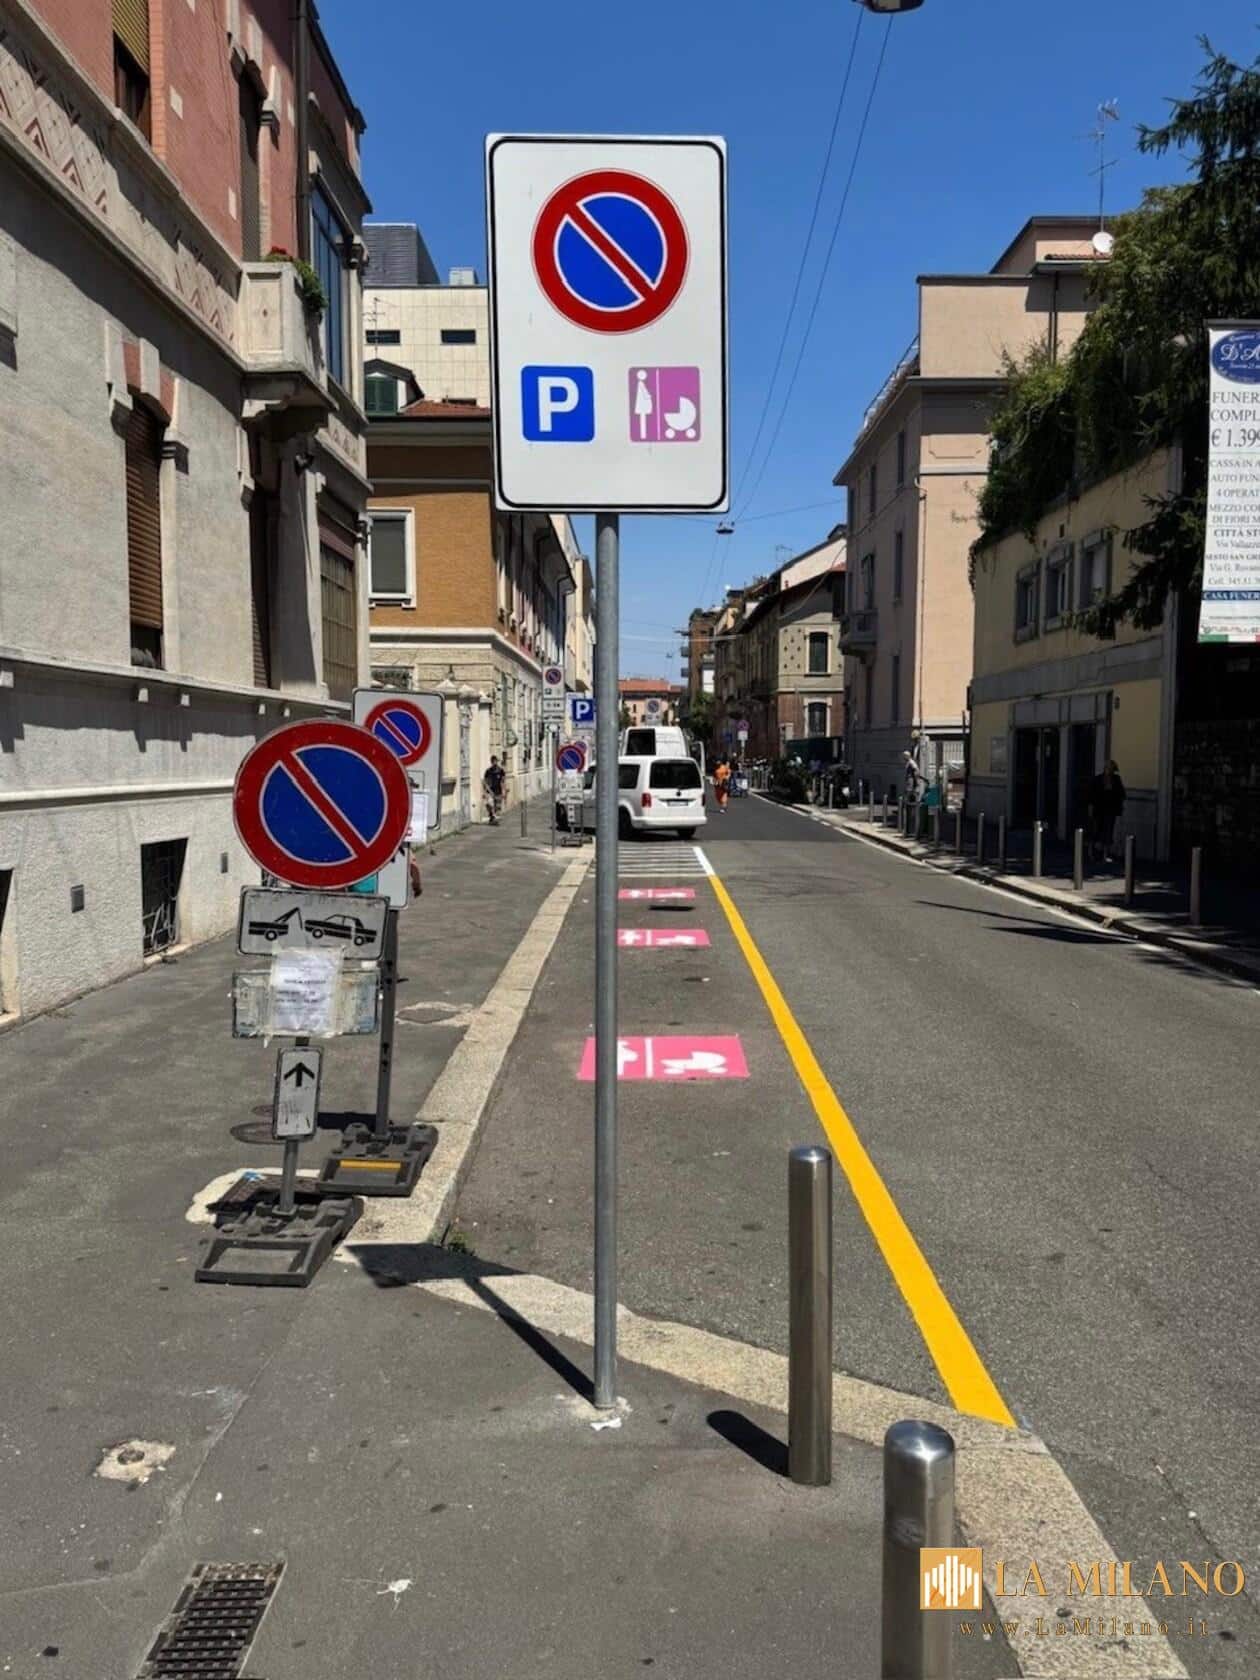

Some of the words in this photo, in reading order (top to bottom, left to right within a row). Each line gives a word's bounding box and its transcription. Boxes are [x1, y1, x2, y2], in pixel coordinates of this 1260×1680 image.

[537, 376, 580, 432] P
[1211, 428, 1222, 447] €
[575, 701, 590, 720] P
